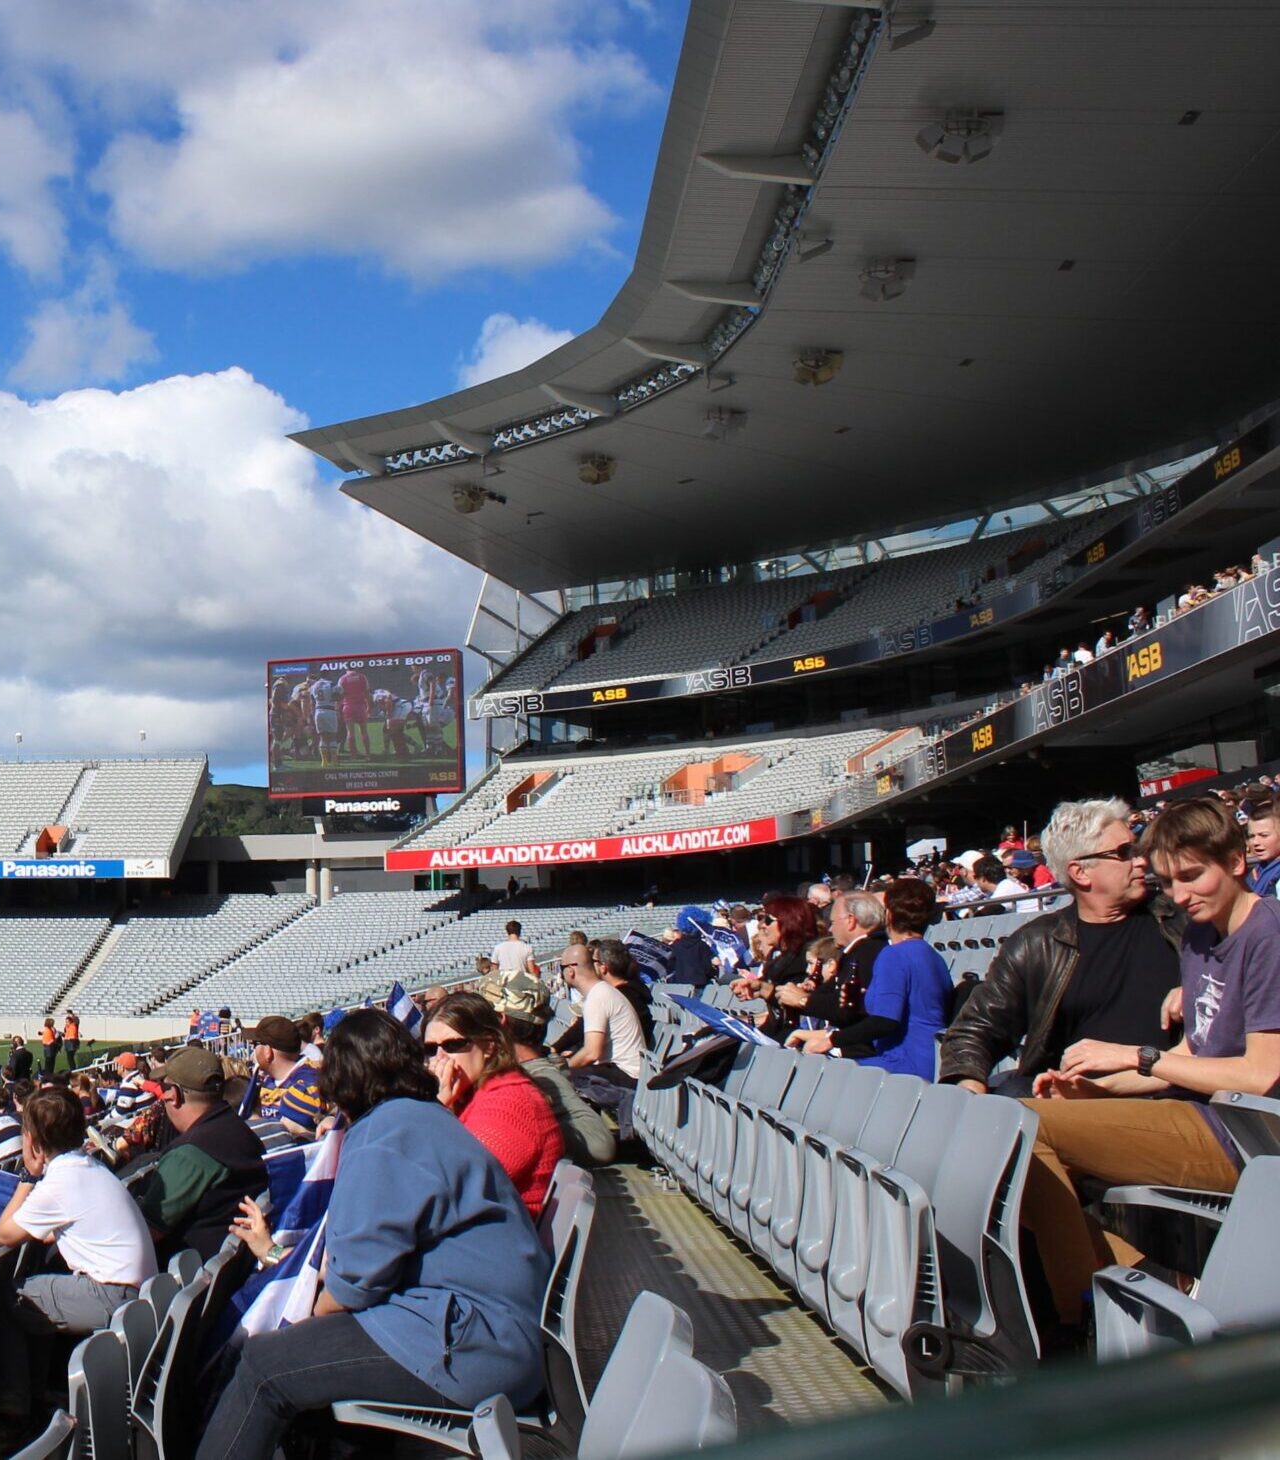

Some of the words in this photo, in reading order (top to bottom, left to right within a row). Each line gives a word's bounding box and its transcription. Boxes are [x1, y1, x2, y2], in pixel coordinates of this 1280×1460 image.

[1214, 447, 1241, 480] ASB
[970, 608, 994, 628] ASB
[320, 661, 348, 672] AUK
[350, 660, 364, 668] 00
[368, 658, 400, 666] 03:21
[405, 656, 433, 666] BOP
[437, 654, 451, 663] 00
[793, 656, 826, 672] ASB
[1127, 642, 1162, 681] ASB
[685, 664, 752, 695] ASB
[474, 694, 544, 717] ASB
[593, 688, 627, 702] ASB
[1031, 669, 1084, 734] ASB
[972, 725, 993, 752] ASB
[325, 798, 400, 813] Panasonic
[622, 824, 751, 855] AUCKLANDNZ.COM
[429, 841, 597, 867] AUCKLANDNZ.COM
[2, 860, 96, 878] Panasonic
[922, 1337, 932, 1356] L
